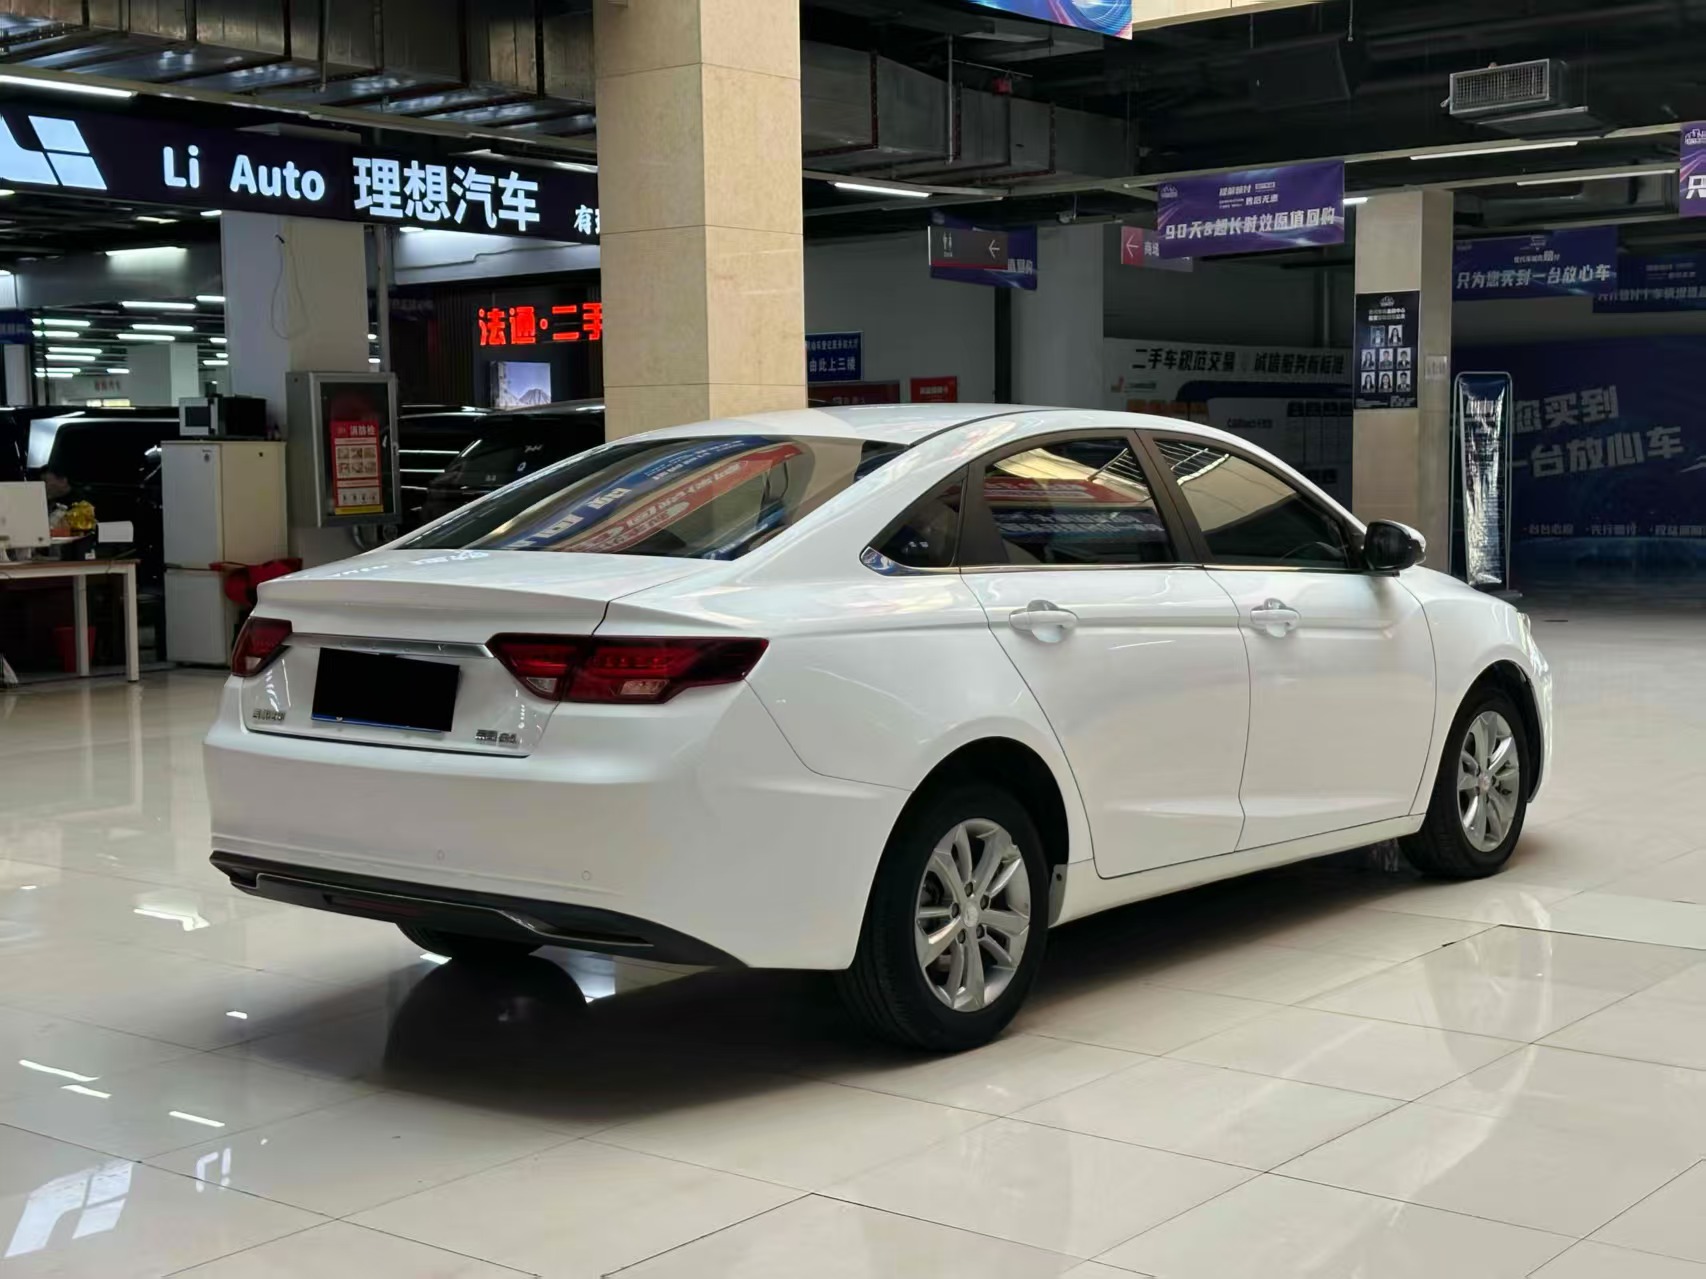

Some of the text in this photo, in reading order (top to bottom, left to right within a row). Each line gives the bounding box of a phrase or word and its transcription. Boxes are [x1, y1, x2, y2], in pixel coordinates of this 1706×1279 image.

[162, 145, 540, 232] Li Auto 理想汽车
[1456, 263, 1611, 289] 只为您买到一台放心车
